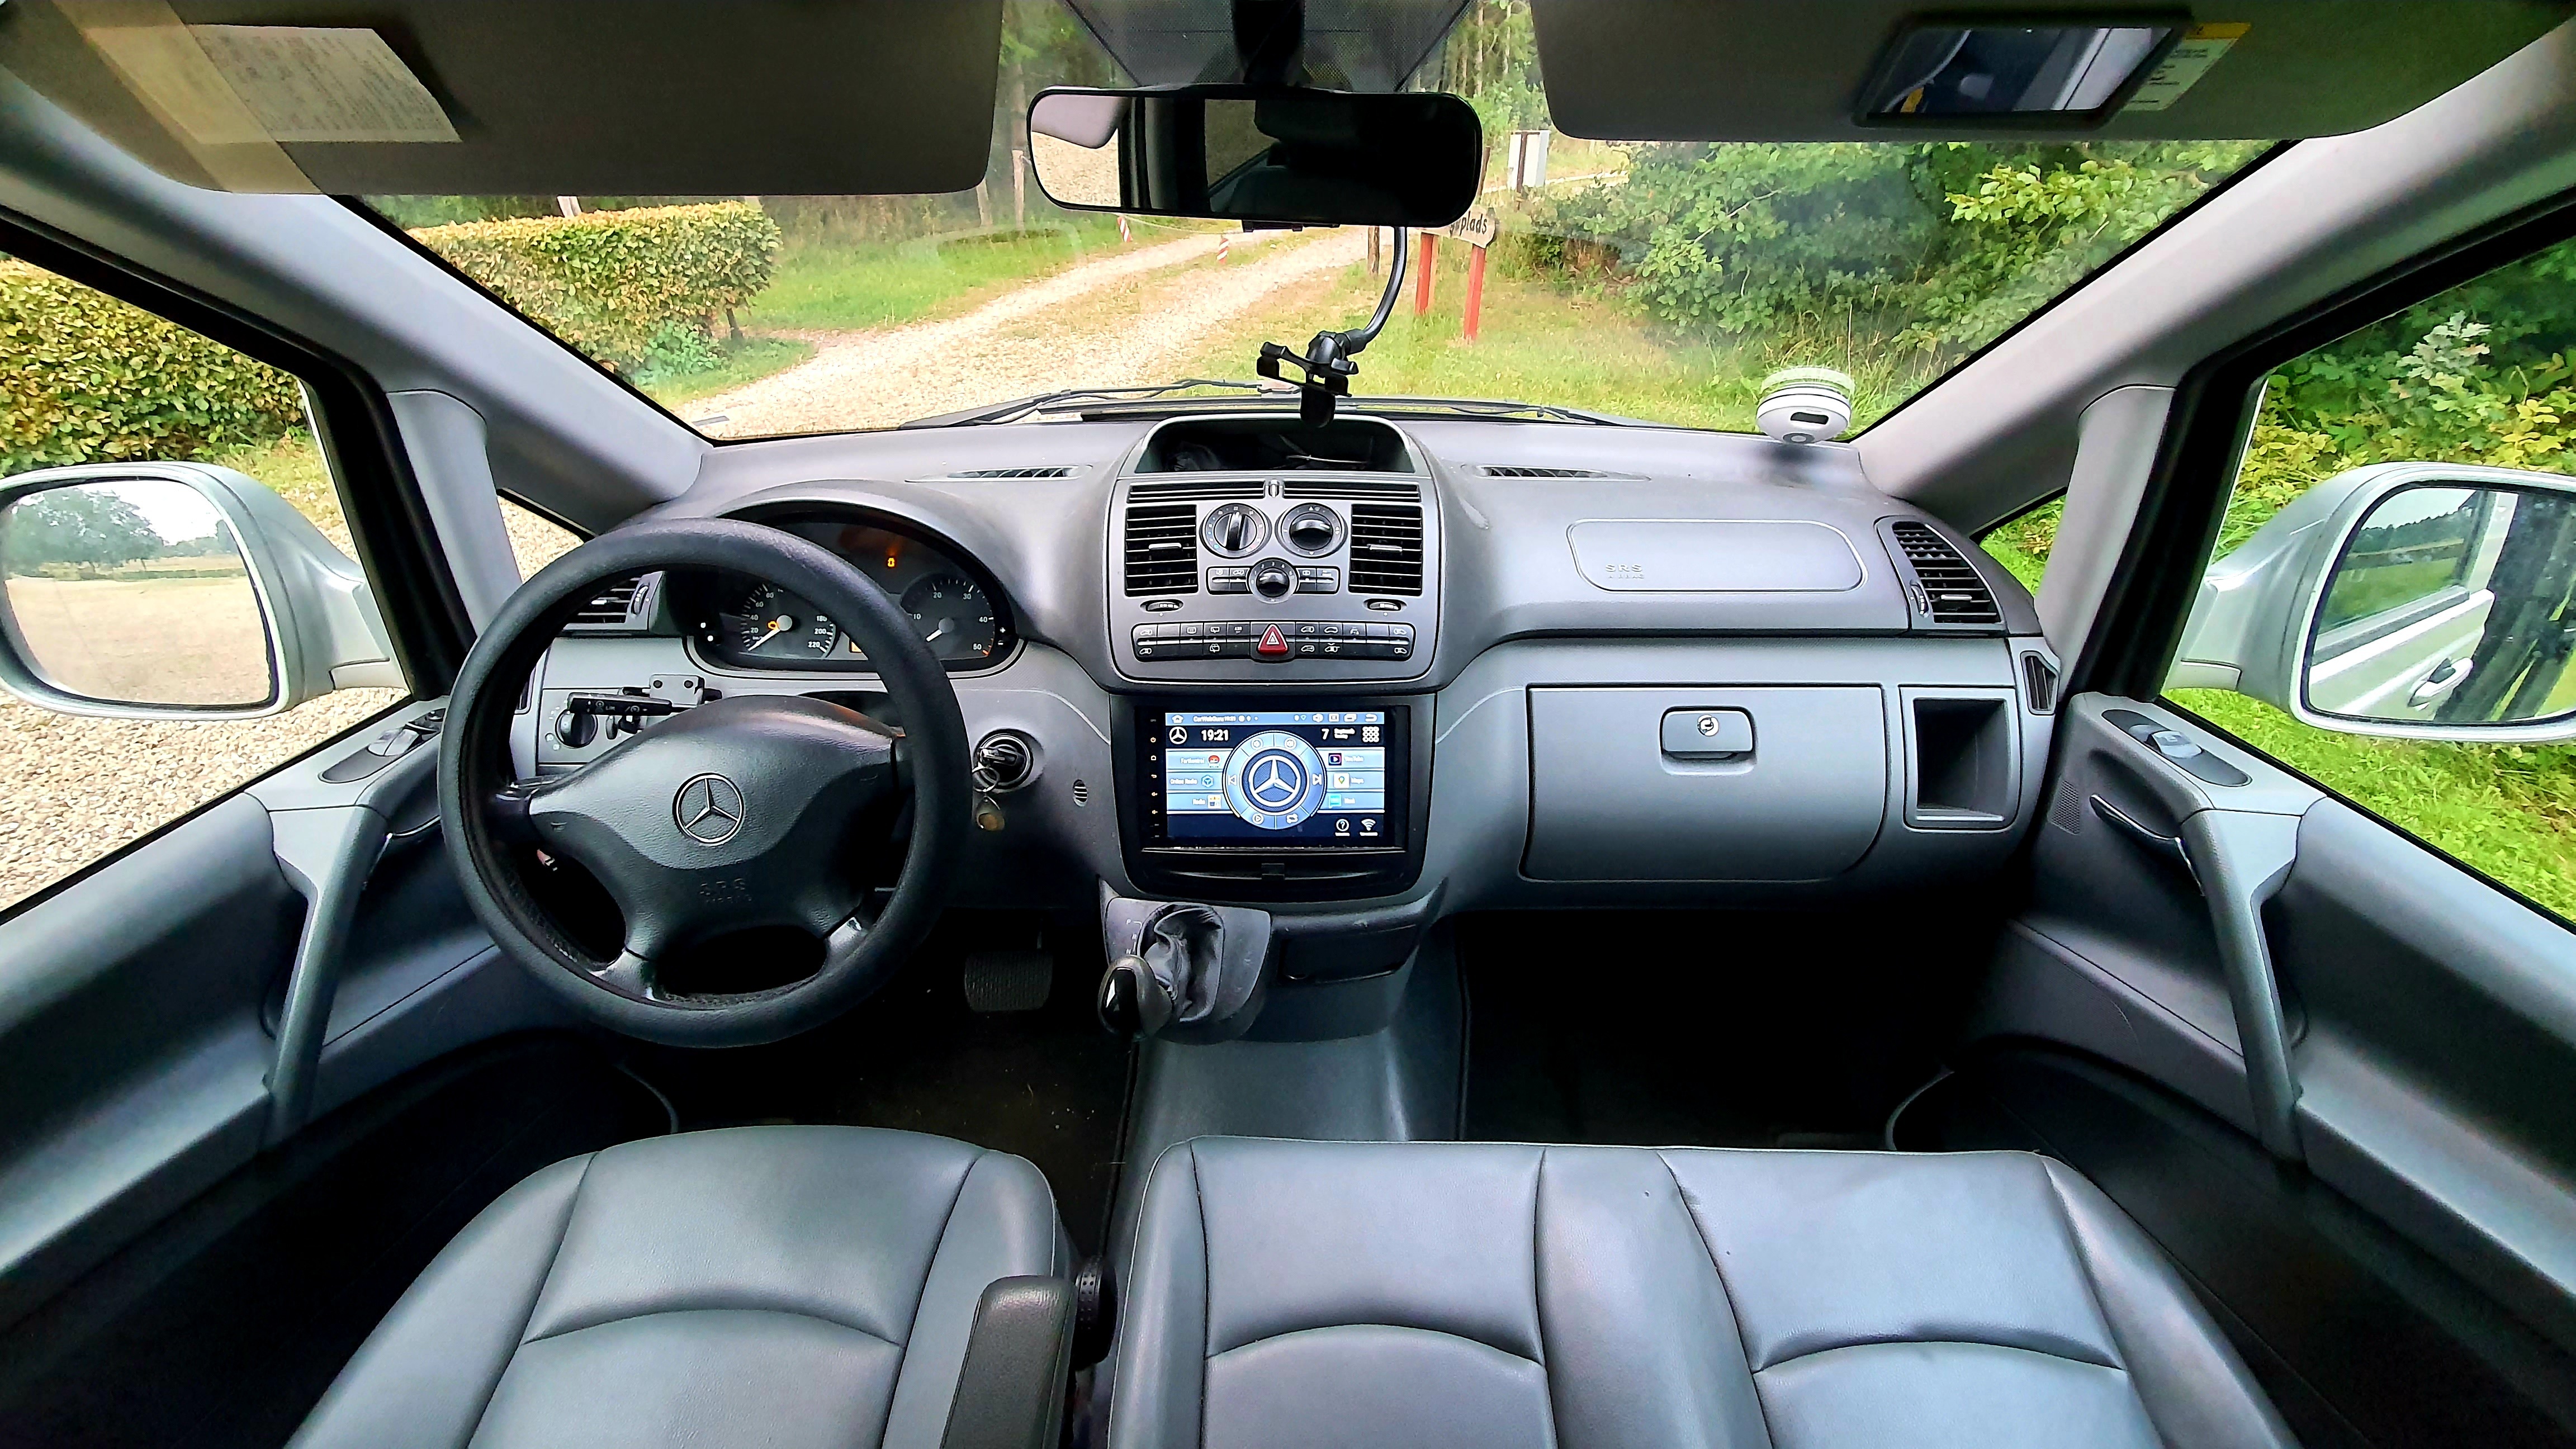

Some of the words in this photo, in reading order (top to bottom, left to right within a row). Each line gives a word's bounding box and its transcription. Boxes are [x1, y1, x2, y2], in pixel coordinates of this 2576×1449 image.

[1606, 564, 1642, 572] SRS
[1201, 729, 1229, 741] 19:21
[1322, 728, 1329, 740] 7
